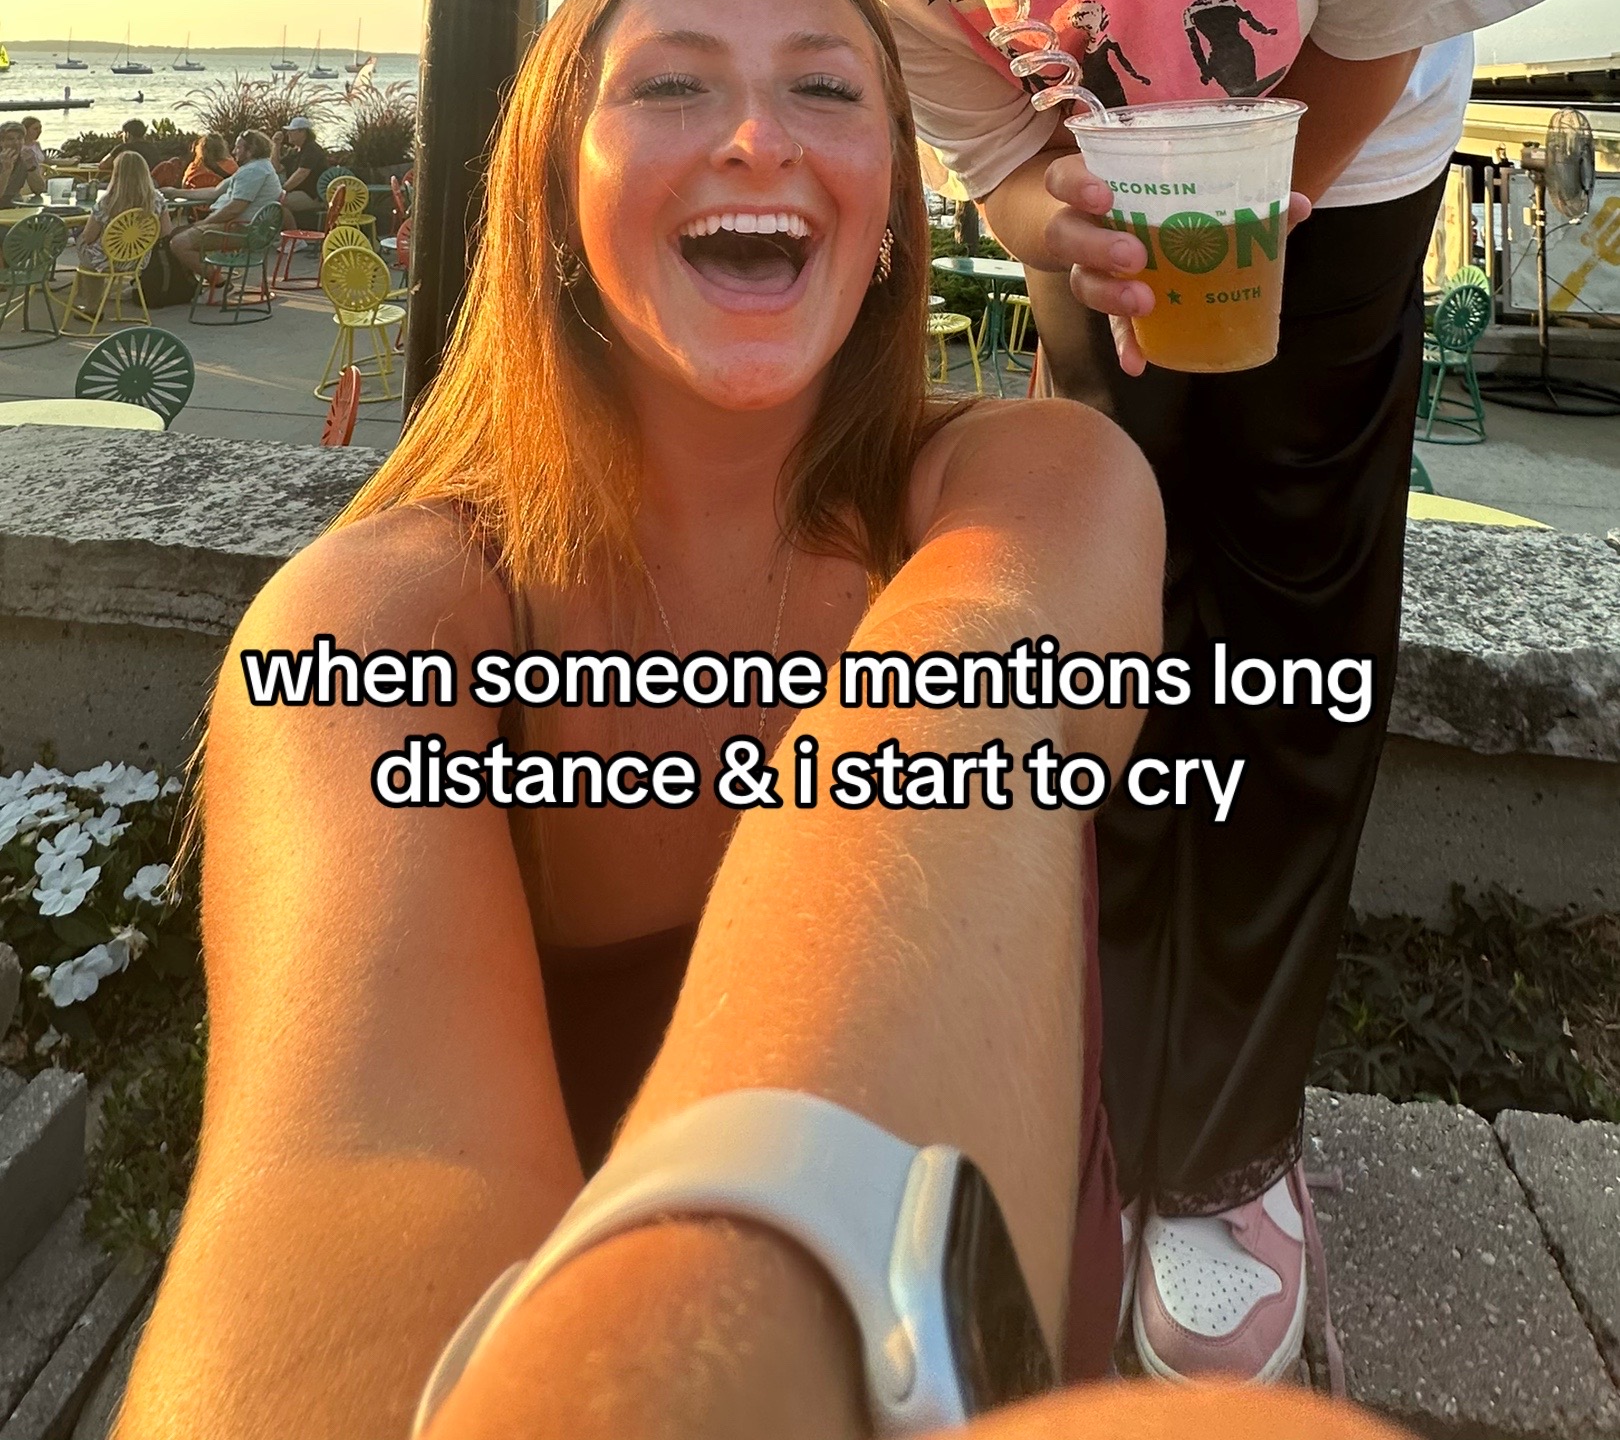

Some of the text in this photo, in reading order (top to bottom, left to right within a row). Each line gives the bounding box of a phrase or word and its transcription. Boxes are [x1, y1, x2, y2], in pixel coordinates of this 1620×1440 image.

[1105, 179, 1197, 196] SCONSIN
[1103, 200, 1282, 275] ION
[1205, 286, 1262, 304] SOUTH
